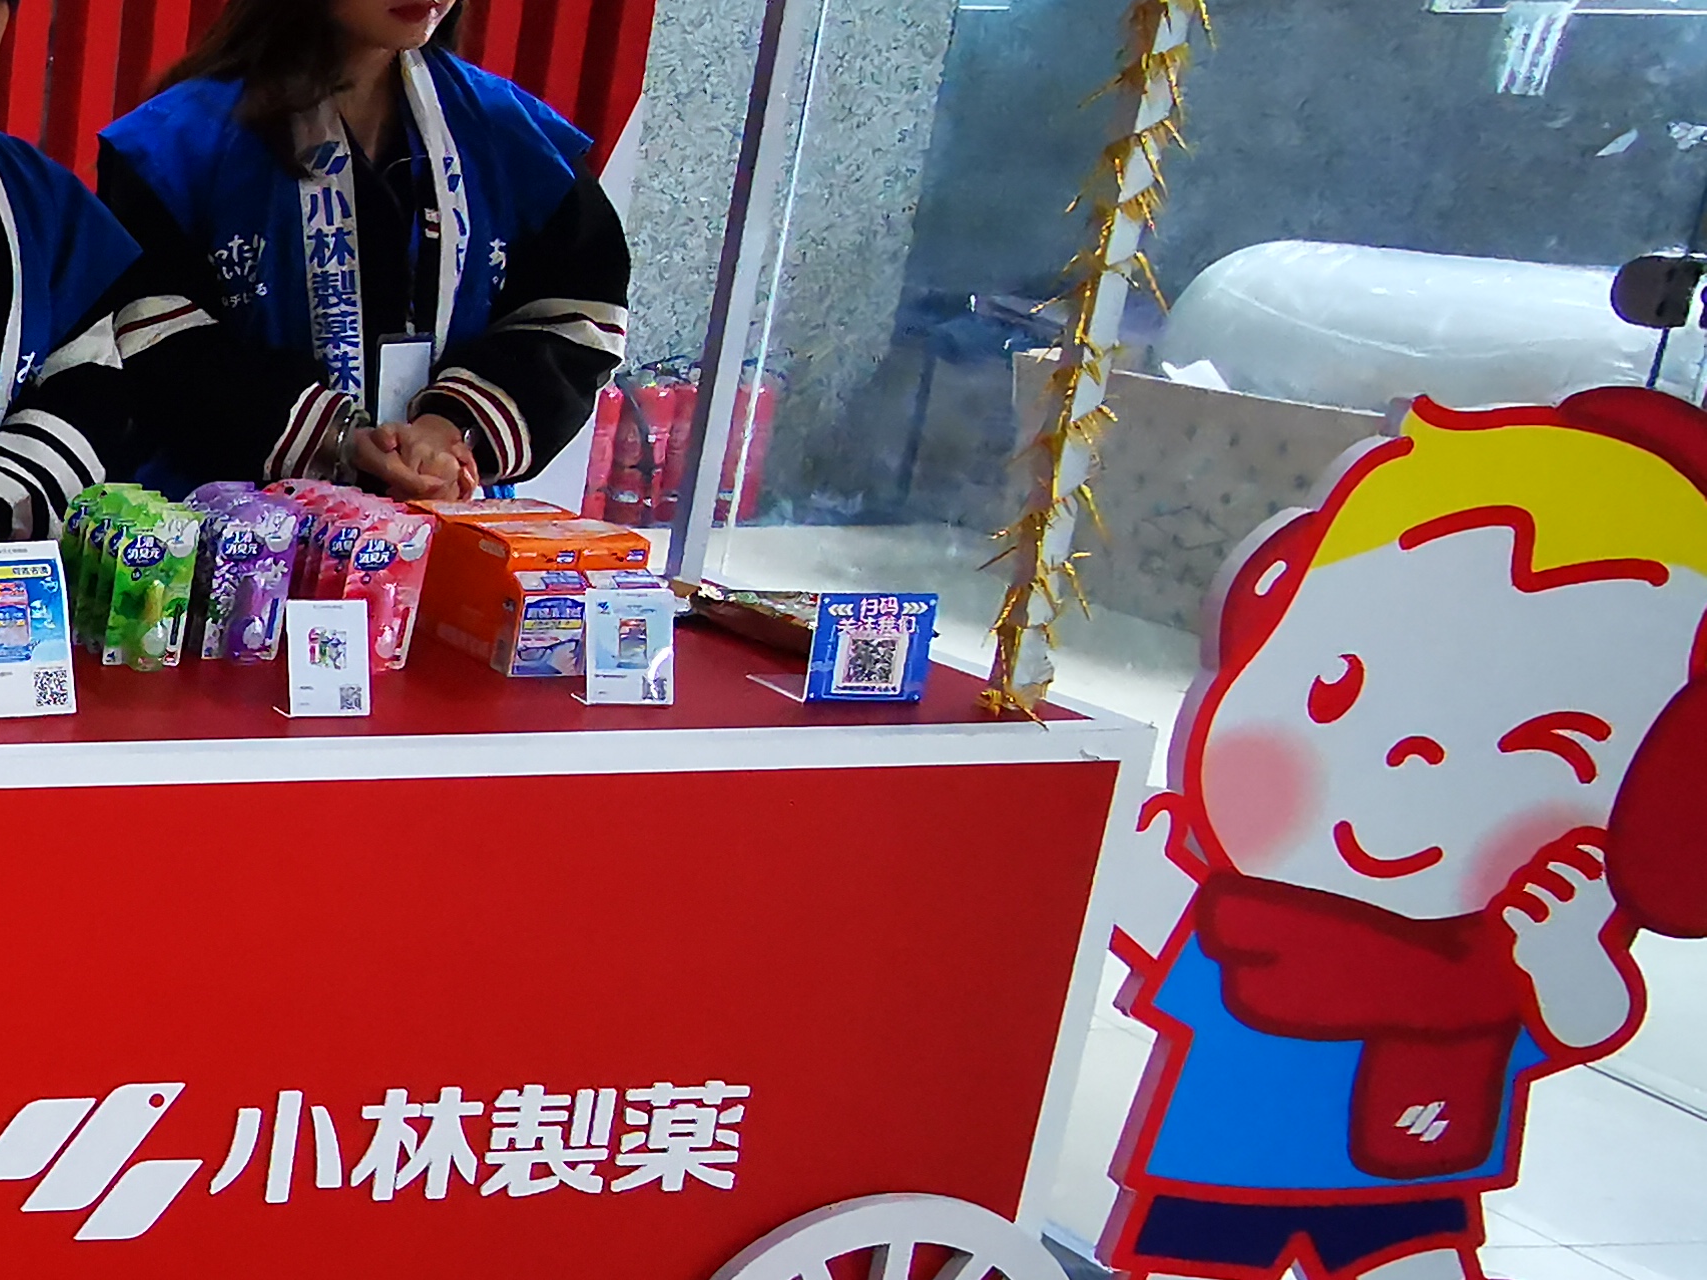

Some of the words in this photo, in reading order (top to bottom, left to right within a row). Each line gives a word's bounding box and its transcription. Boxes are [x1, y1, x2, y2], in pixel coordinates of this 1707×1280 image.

[307, 187, 360, 402] 小林製薬株
[210, 1080, 752, 1204] 小林製薬
